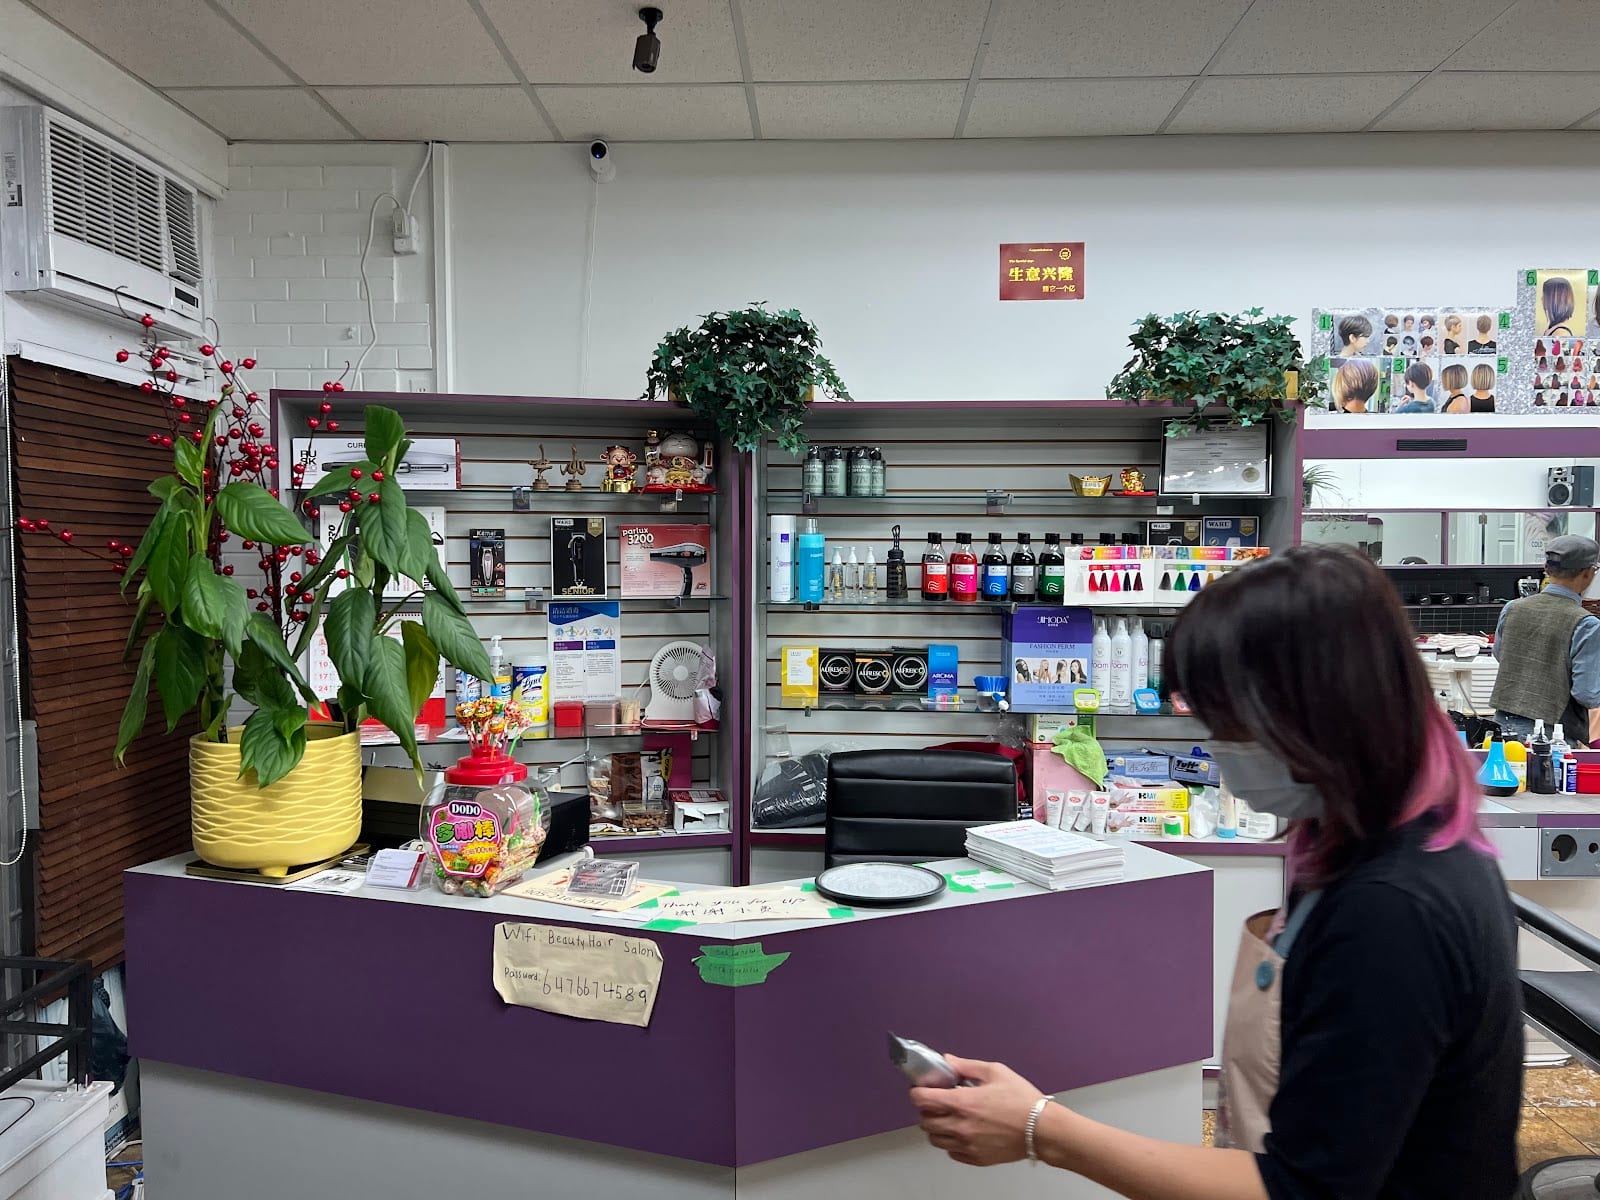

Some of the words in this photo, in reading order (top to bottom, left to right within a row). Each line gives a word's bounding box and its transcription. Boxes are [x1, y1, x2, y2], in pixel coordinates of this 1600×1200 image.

[1008, 266, 1074, 282] 生意兴隆
[622, 528, 649, 537] parlux
[628, 533, 654, 545] 3200
[562, 587, 595, 595] SENIOR
[451, 804, 480, 816] DODO
[623, 941, 655, 958] Salon
